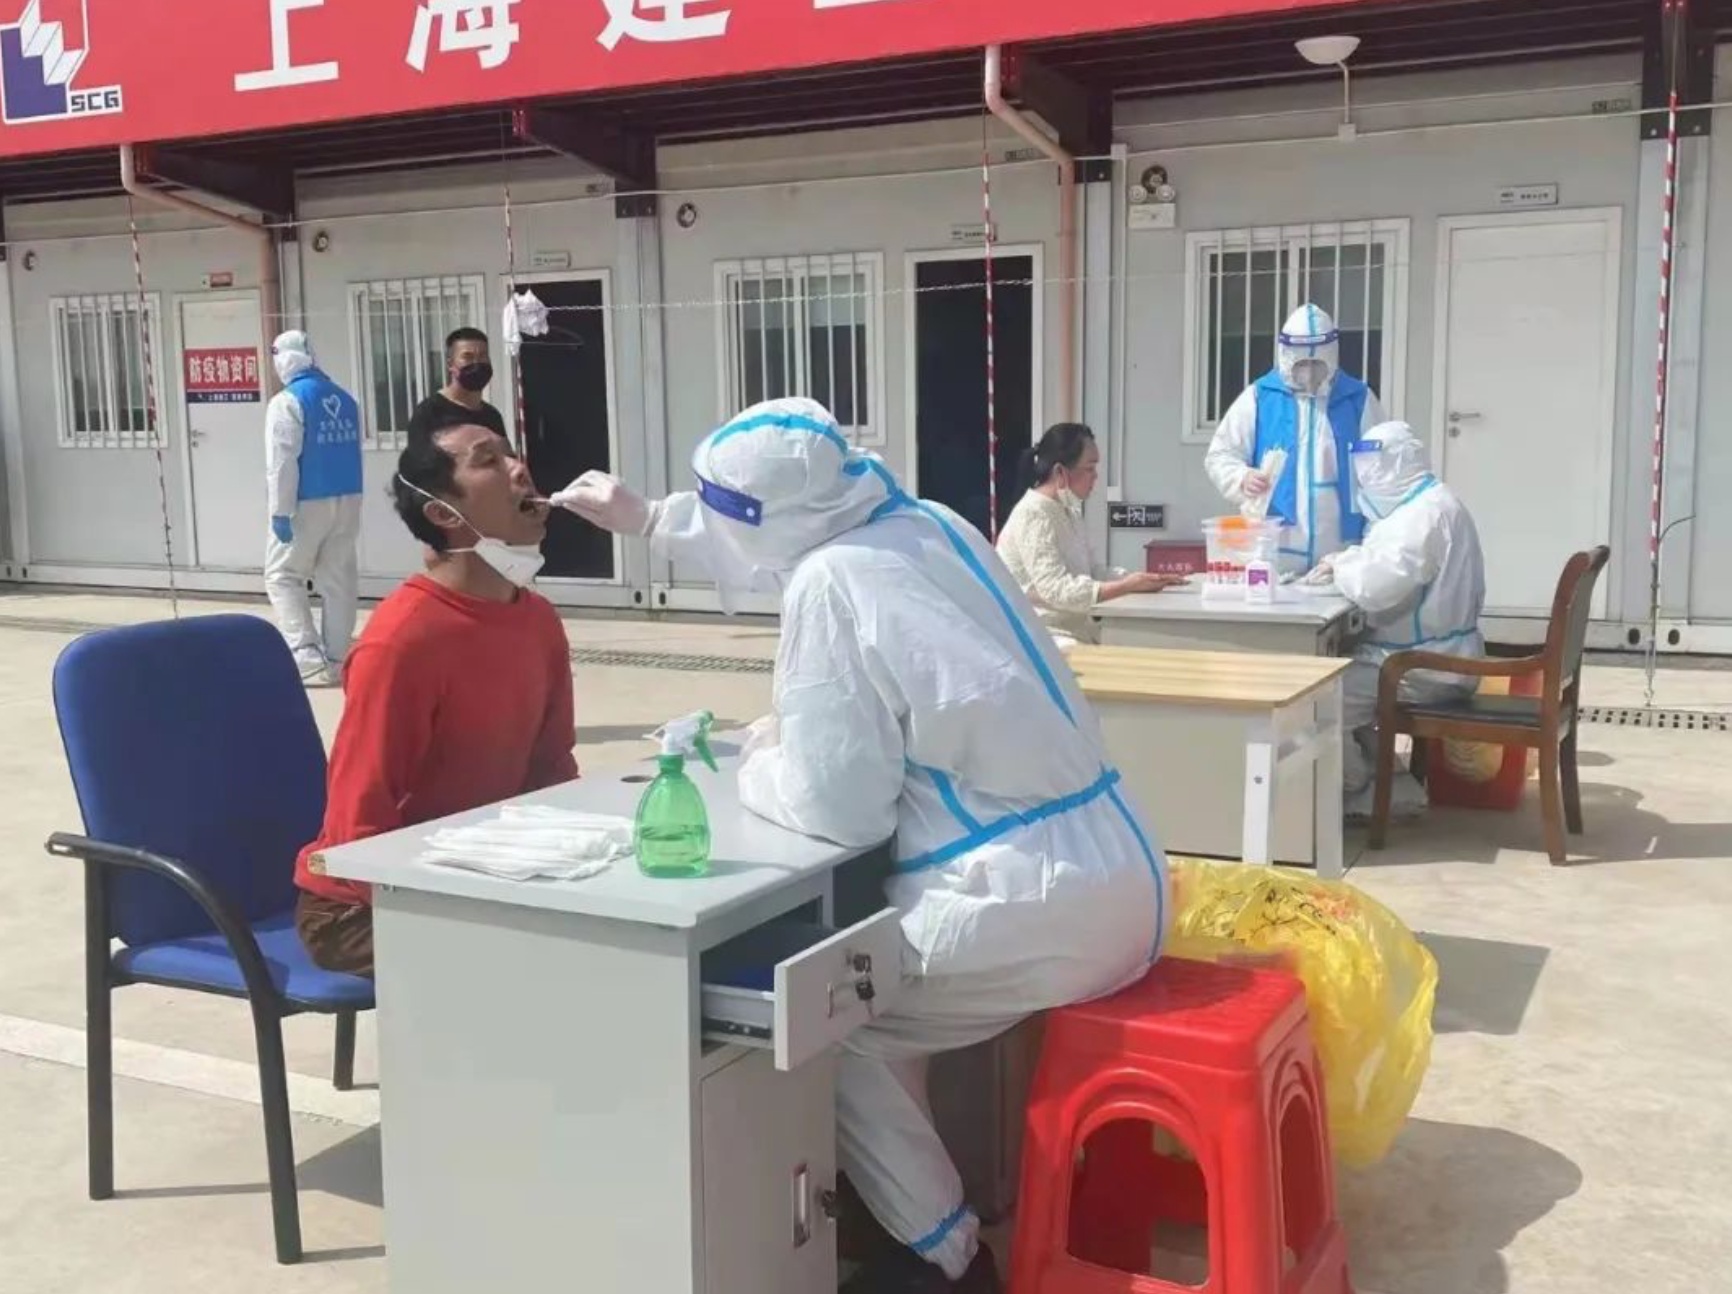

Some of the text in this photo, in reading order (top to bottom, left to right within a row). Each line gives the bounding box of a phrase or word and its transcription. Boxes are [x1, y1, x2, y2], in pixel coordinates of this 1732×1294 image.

[234, 0, 897, 91] 上海
[70, 89, 120, 114] SCG
[188, 355, 258, 384] 防疫物资间
